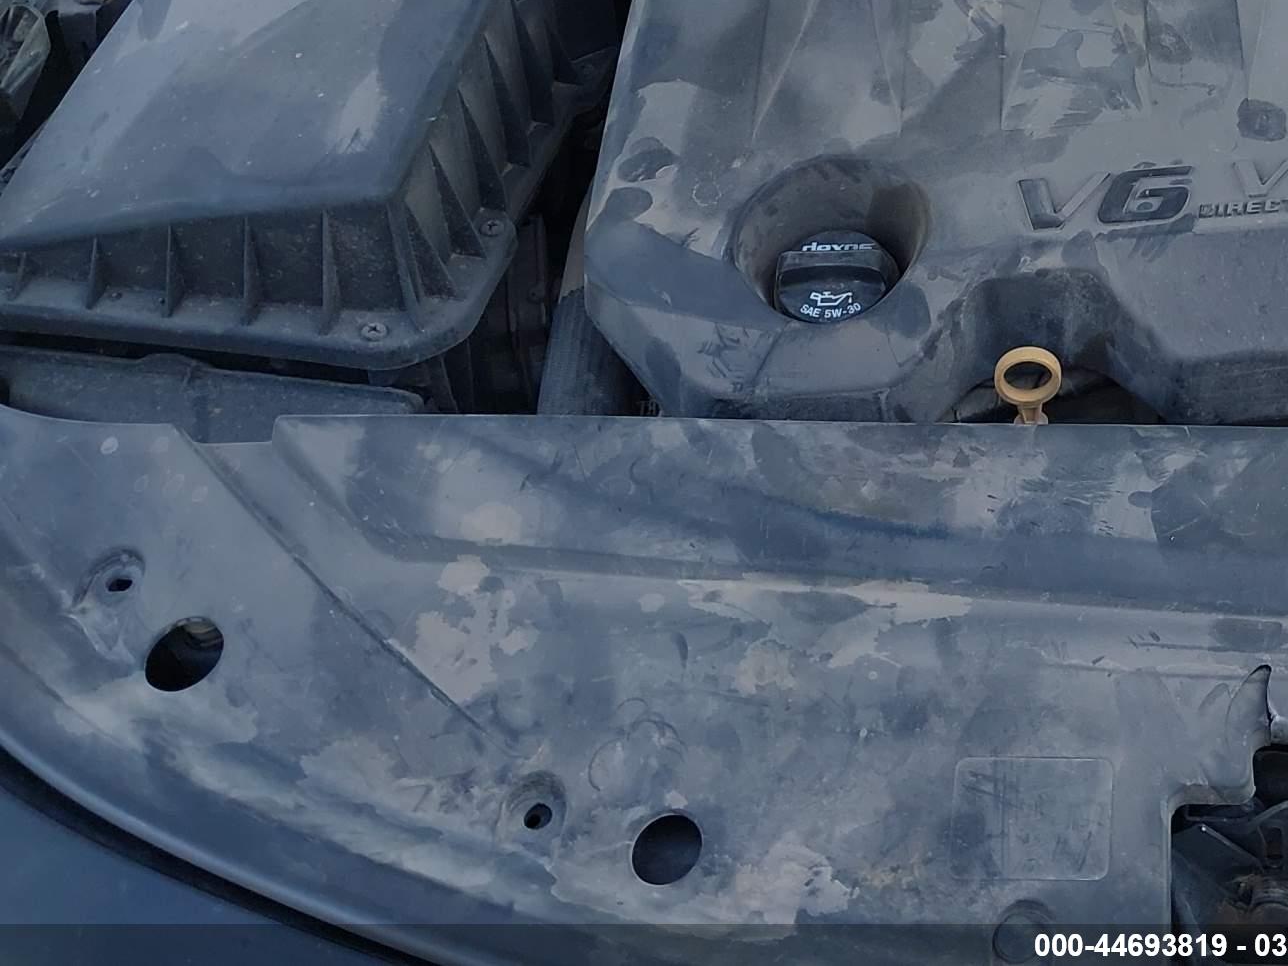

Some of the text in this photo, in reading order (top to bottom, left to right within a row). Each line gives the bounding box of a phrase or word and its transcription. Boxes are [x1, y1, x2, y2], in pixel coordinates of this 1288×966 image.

[1017, 164, 1193, 231] V6
[800, 302, 861, 319] SAE 5W-30
